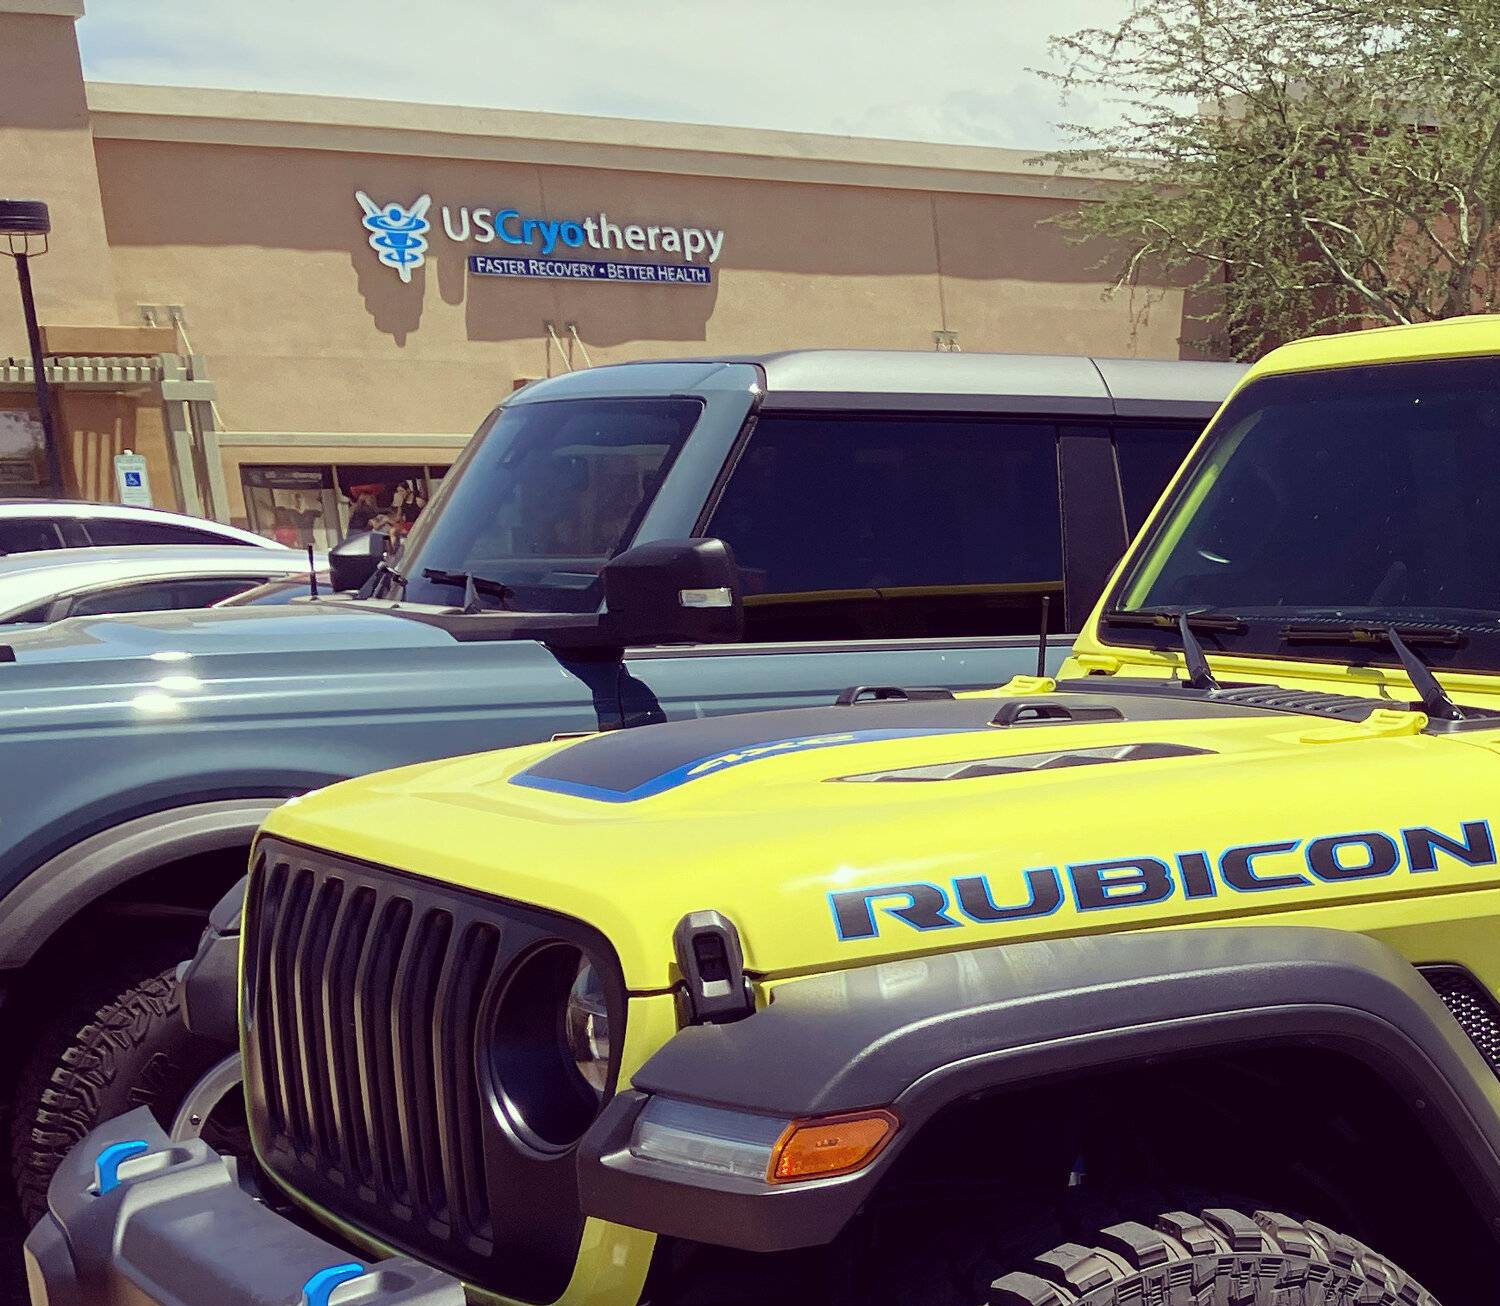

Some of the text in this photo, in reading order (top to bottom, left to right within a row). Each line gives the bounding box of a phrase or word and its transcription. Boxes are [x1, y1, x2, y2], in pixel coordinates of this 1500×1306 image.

[476, 257, 706, 283] FASTER RECOVERY BETTER HEALTH
[828, 819, 1497, 942] RUBICON
